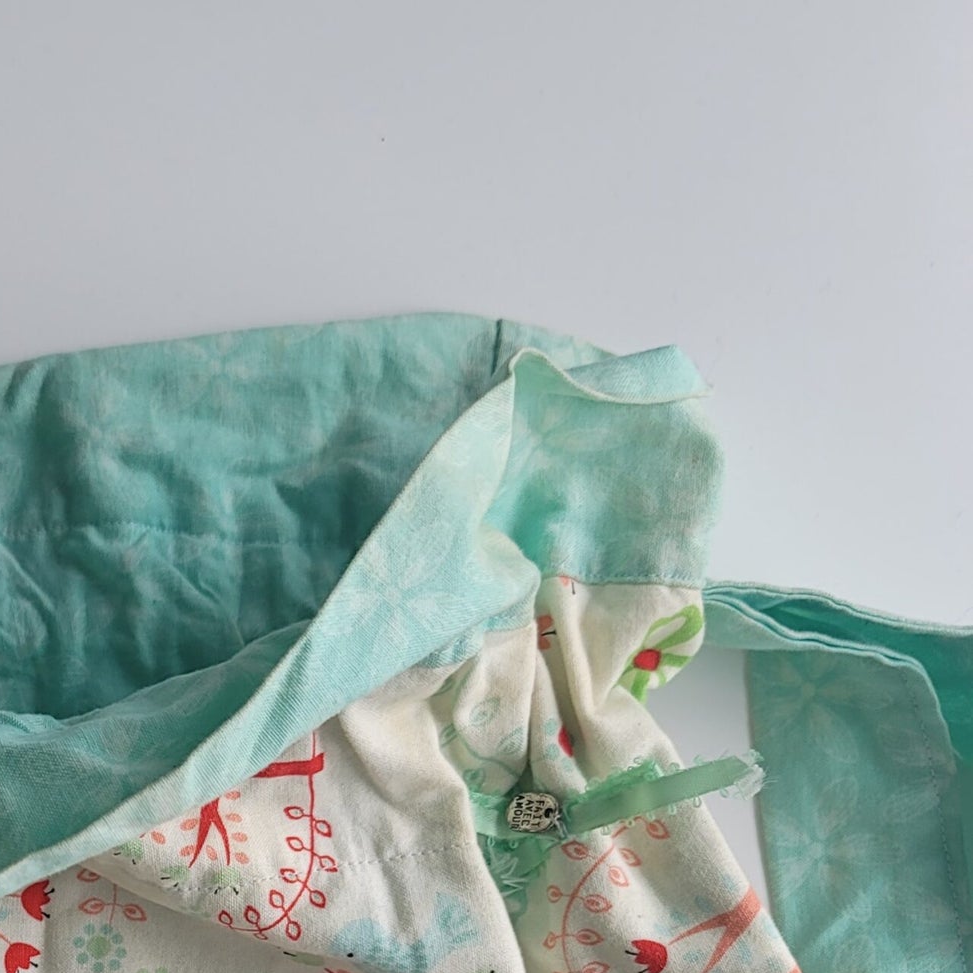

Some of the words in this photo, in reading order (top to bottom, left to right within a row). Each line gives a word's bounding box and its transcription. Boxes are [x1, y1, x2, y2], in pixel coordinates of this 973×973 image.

[511, 795, 525, 829] AMOUR
[521, 799, 534, 826] AVEC
[531, 800, 545, 827] FAIT
